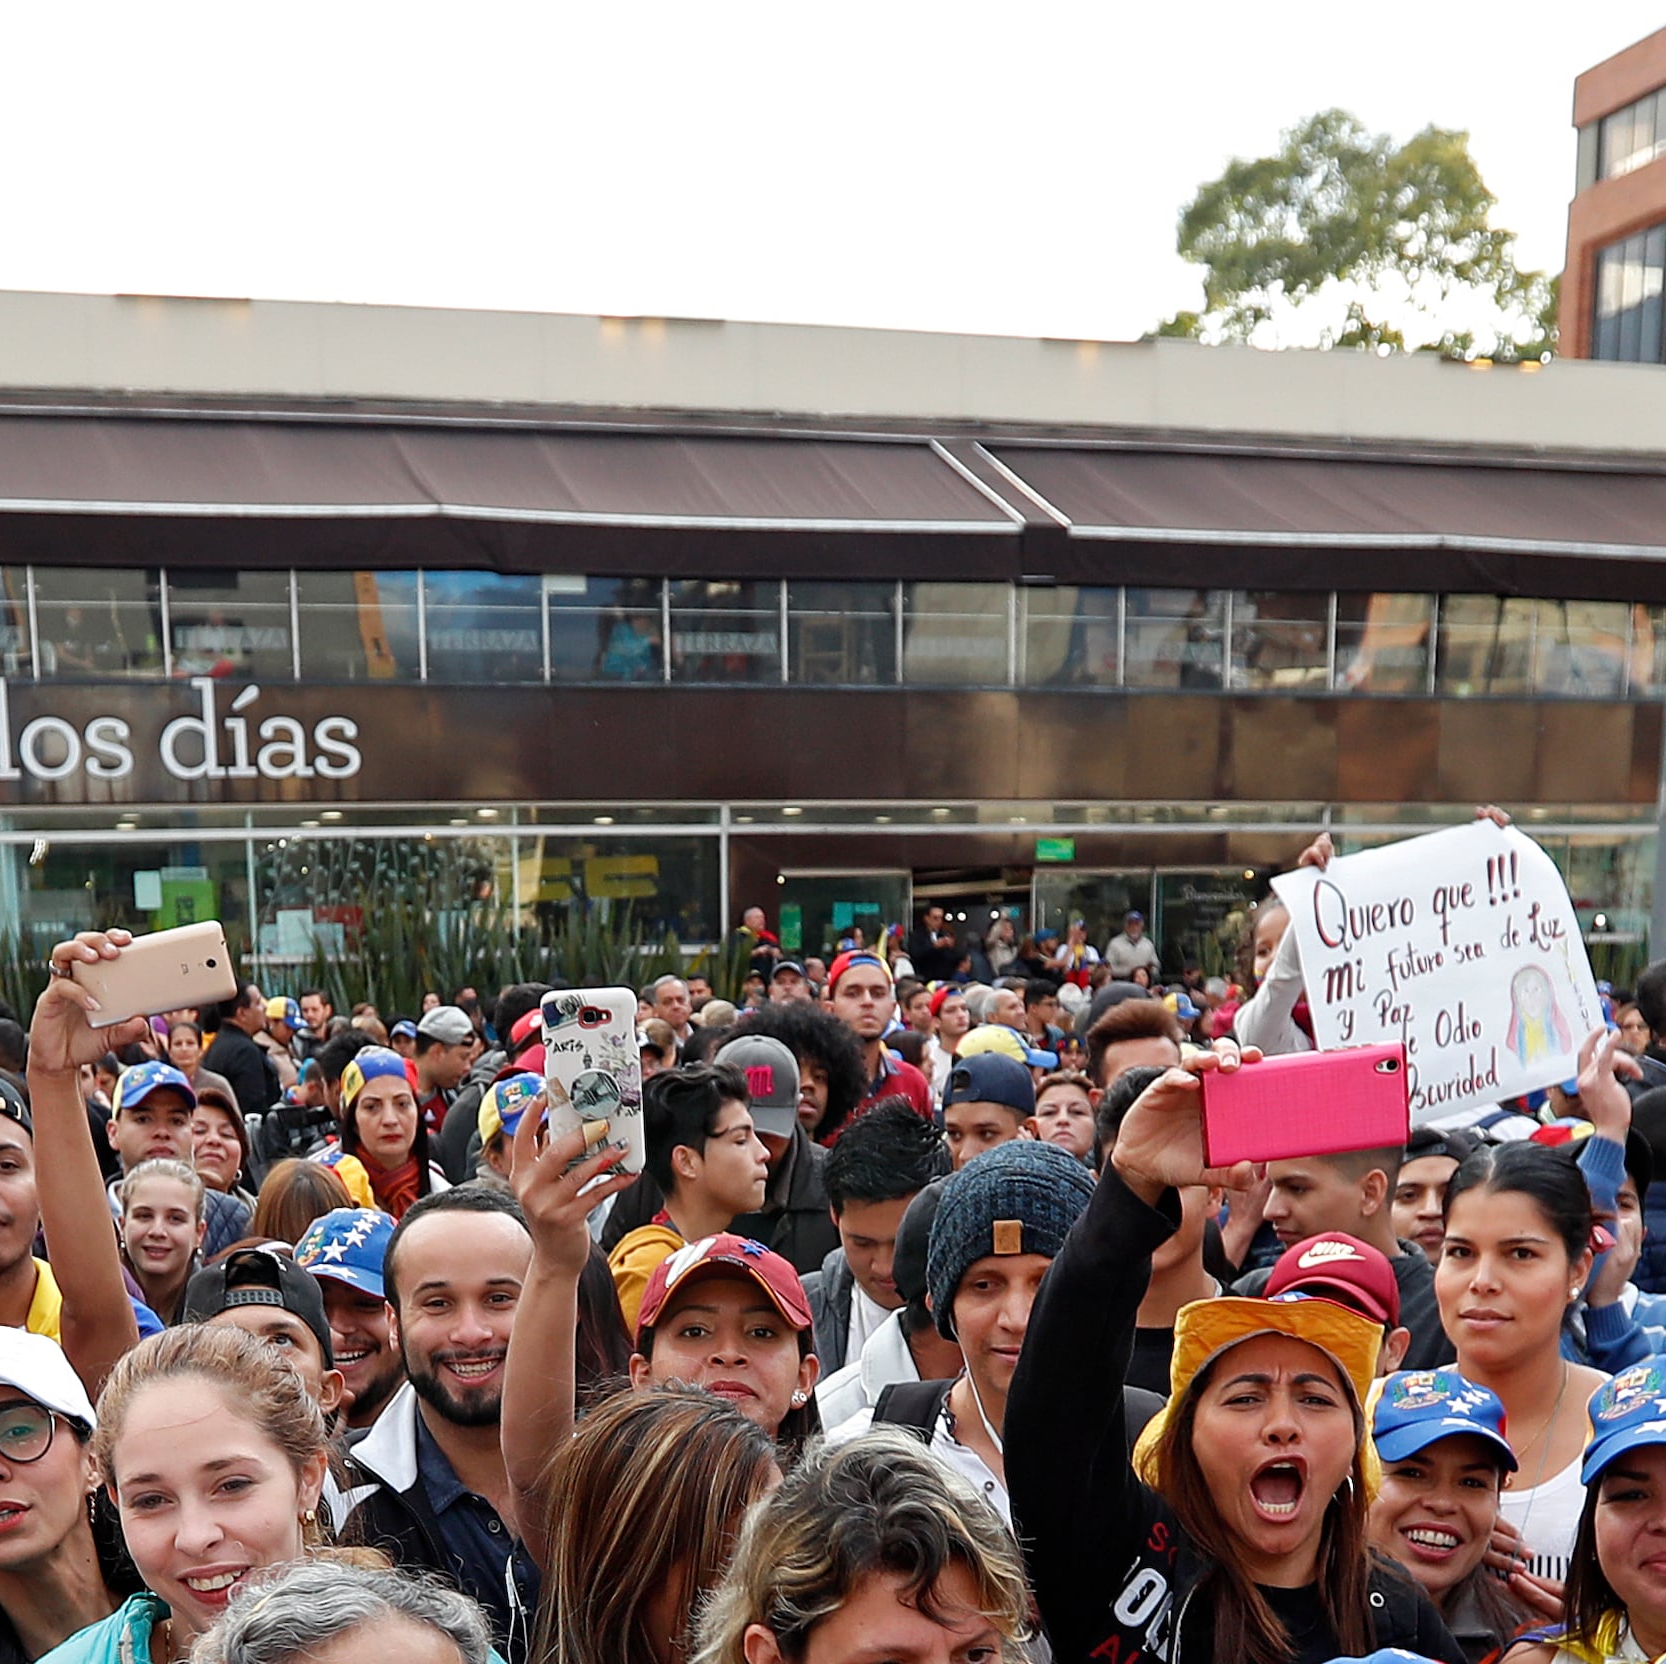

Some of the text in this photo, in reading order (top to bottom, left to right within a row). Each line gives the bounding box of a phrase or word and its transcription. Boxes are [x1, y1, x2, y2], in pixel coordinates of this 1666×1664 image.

[159, 677, 363, 781] días
[1314, 879, 1416, 952] Quiero
[1432, 882, 1476, 945] que
[1322, 958, 1366, 1005] mi
[1453, 943, 1487, 965] sea
[1500, 914, 1522, 950] de
[1528, 901, 1567, 954] Luz
[1336, 988, 1416, 1043] y Paz
[1434, 1000, 1483, 1049] Odio
[1309, 1240, 1357, 1256] NIKE
